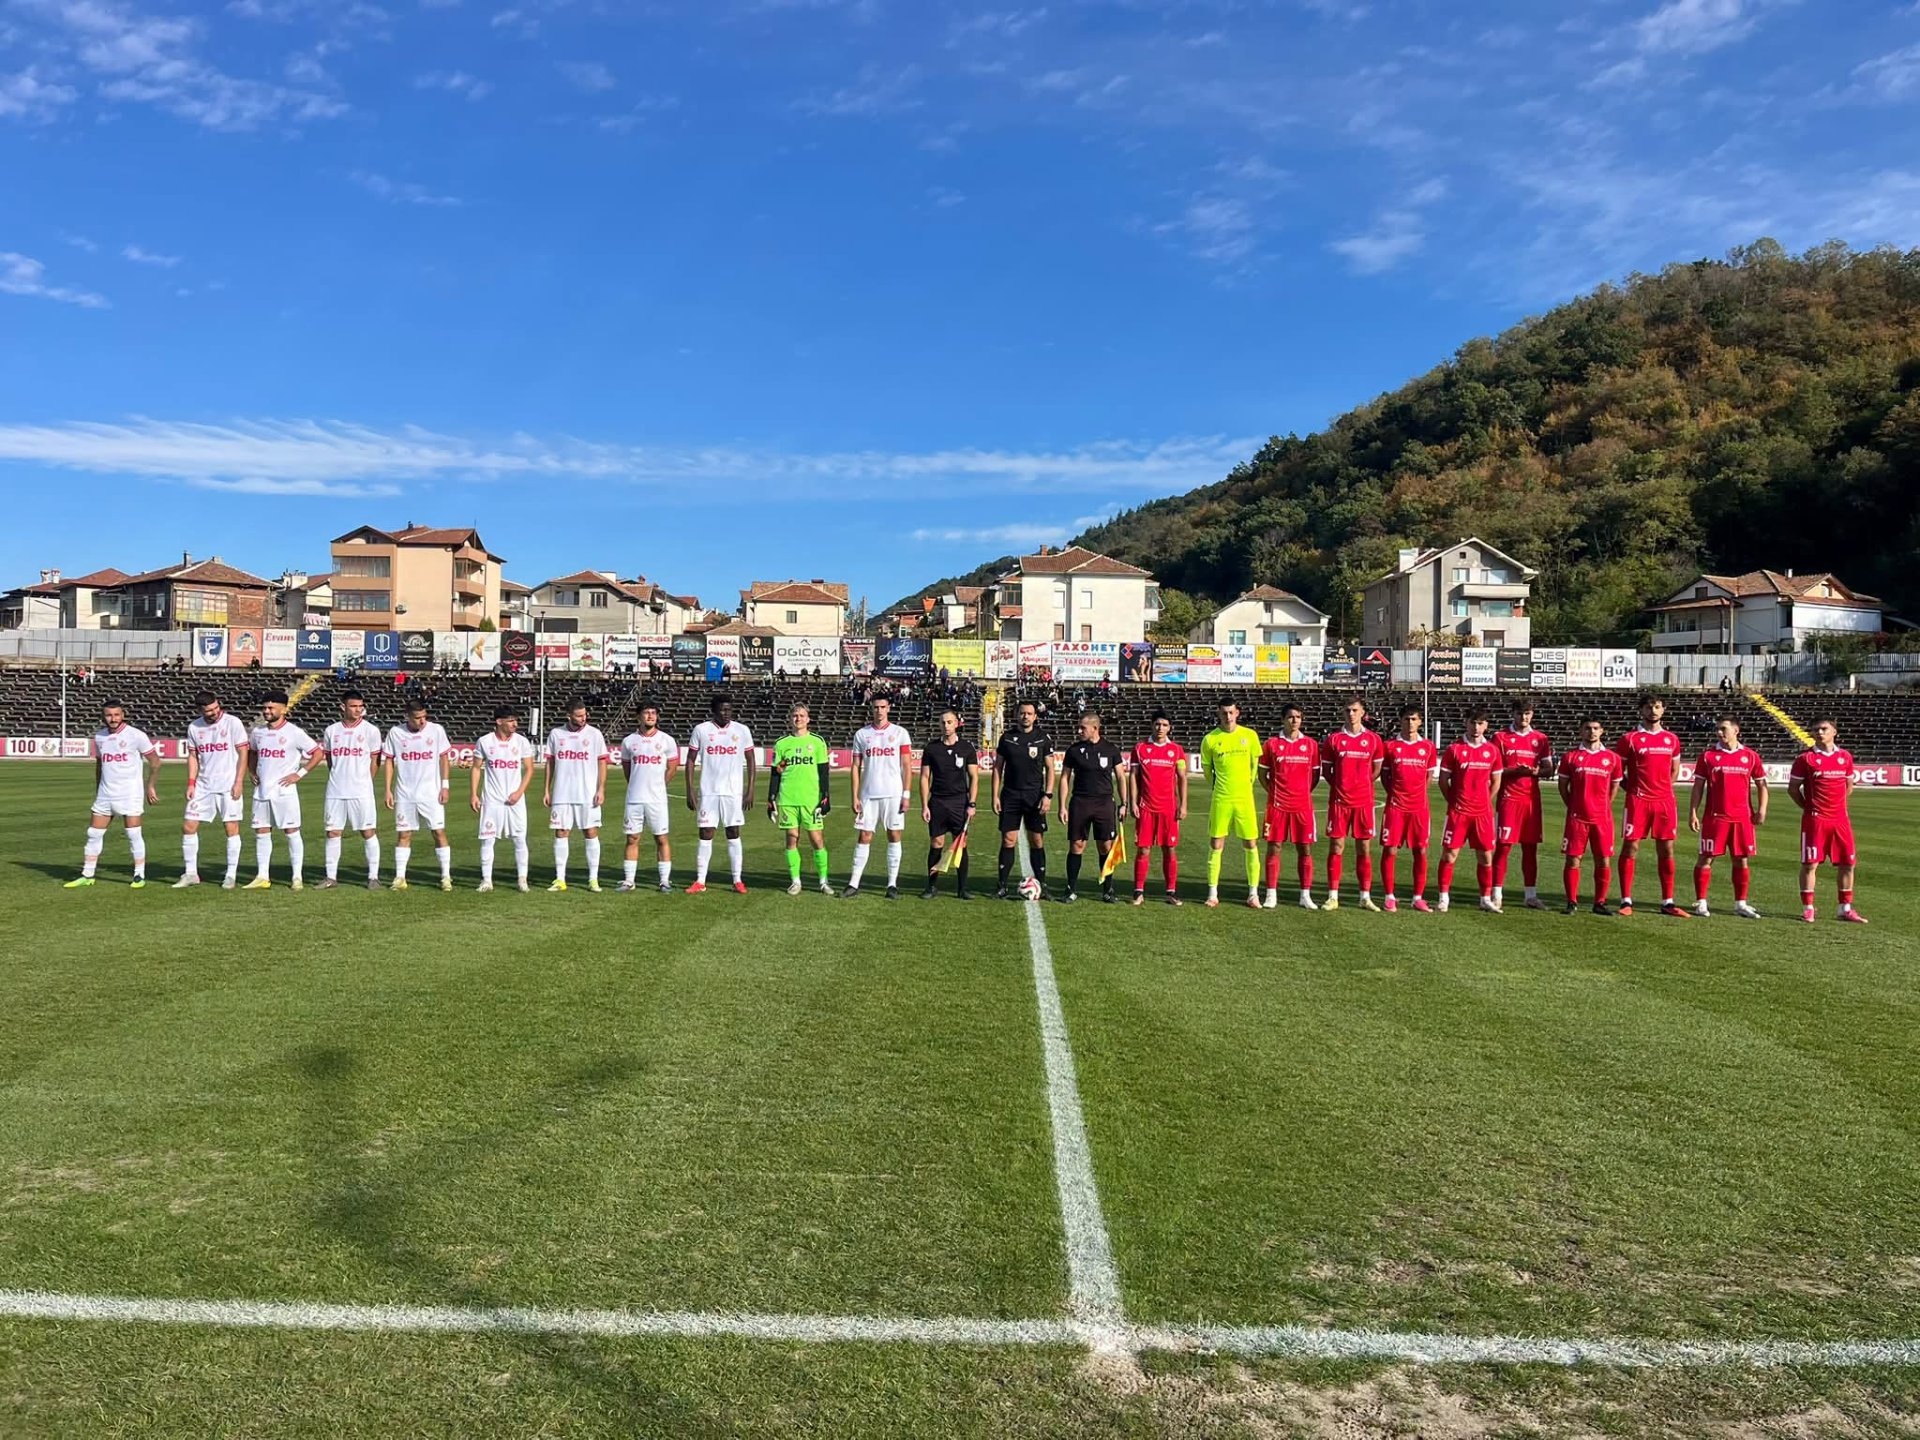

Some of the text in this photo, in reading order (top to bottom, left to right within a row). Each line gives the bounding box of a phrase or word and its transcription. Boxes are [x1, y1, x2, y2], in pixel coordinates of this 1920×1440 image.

[265, 632, 295, 642] Evans
[1054, 643, 1116, 652] ТАХОНЕТ
[366, 654, 398, 662] ETICOM
[1533, 651, 1564, 660] DIES
[1533, 664, 1564, 672] DIES
[1568, 659, 1600, 669] CITY
[1533, 676, 1564, 684] DIES
[11, 740, 36, 753] 100
[198, 742, 228, 753] efbet
[332, 747, 363, 757] efbet
[707, 745, 738, 755] efbet
[865, 746, 895, 757] efbet
[102, 752, 128, 762] fbet
[260, 747, 286, 759] fbet
[401, 750, 433, 761] efbet
[557, 750, 589, 761] efbet
[488, 759, 518, 769] efbet
[633, 755, 662, 765] efbet
[785, 756, 813, 767] efbet
[1853, 767, 1888, 783] bet
[1907, 768, 1920, 782] 10
[1263, 823, 1271, 836] 3
[1382, 828, 1390, 842] 2
[1625, 824, 1634, 836] 9
[1444, 831, 1453, 844] 5
[1702, 838, 1714, 852] 10
[1806, 846, 1818, 860] 11
